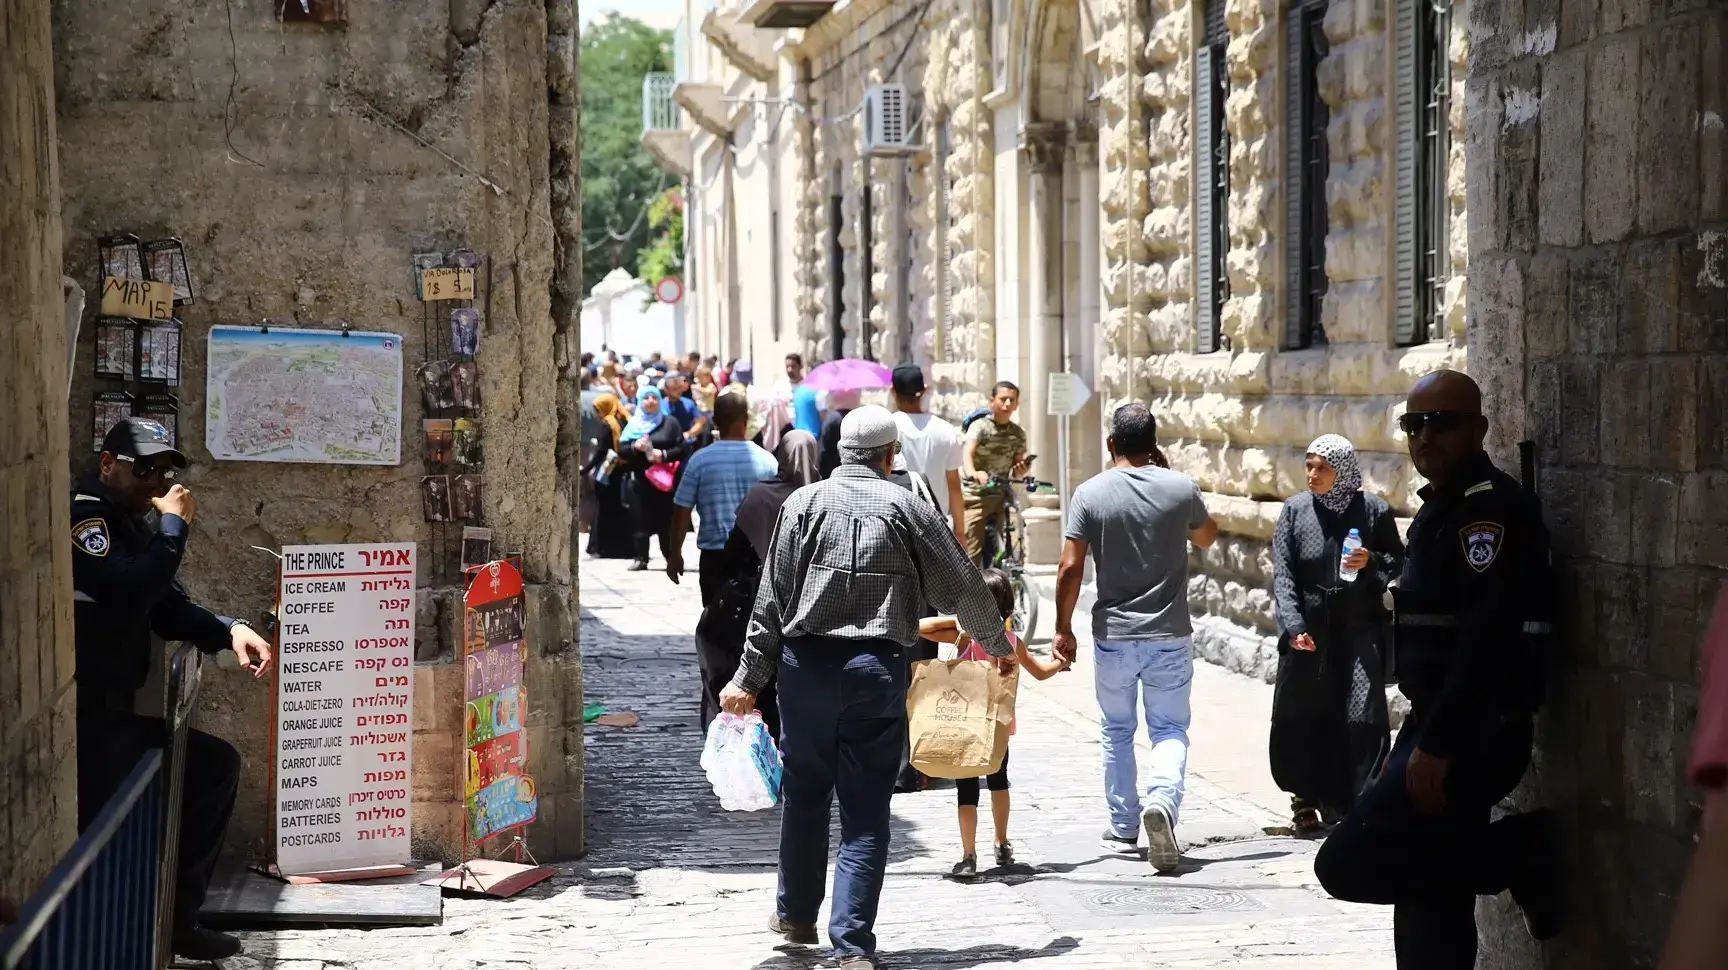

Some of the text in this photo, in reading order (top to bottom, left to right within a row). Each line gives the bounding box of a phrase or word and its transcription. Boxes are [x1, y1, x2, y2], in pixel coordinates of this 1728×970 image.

[103, 279, 151, 305] MAP
[285, 552, 344, 571] THE PRINCE
[359, 549, 410, 566] אמיר
[285, 582, 346, 594] ICE CREAM
[361, 577, 410, 592] גלידות
[285, 602, 334, 615] COFFEE
[379, 599, 410, 611] קפה
[285, 624, 309, 635] TEA
[385, 619, 409, 629] תה
[284, 641, 344, 653] ESPRESSO
[355, 637, 408, 649] אספרסו
[284, 661, 343, 674] NESCAFE
[355, 657, 408, 671] נס קפה
[284, 681, 322, 693] WATER
[376, 676, 408, 687] מים
[283, 698, 343, 710] COLA-DIET-ZERO
[352, 693, 408, 707] קולה/זירו
[283, 717, 342, 731] ORANGE JUICE
[357, 713, 407, 726] תפוזים
[282, 736, 342, 750] GRAPEFRUIT JUICE
[350, 732, 406, 746] אשכוליות
[282, 756, 341, 769] CARROT JUICE
[378, 752, 406, 762] גזר
[282, 776, 317, 789] MAPS
[364, 770, 406, 783] מפות
[349, 789, 405, 806] כרטיס זיכרון
[281, 797, 341, 812] MEMORY CARDS
[282, 813, 341, 828] BATTERIES
[356, 807, 405, 821] סוללות
[357, 825, 405, 840] גלויות
[281, 832, 341, 847] POSTCARDS
